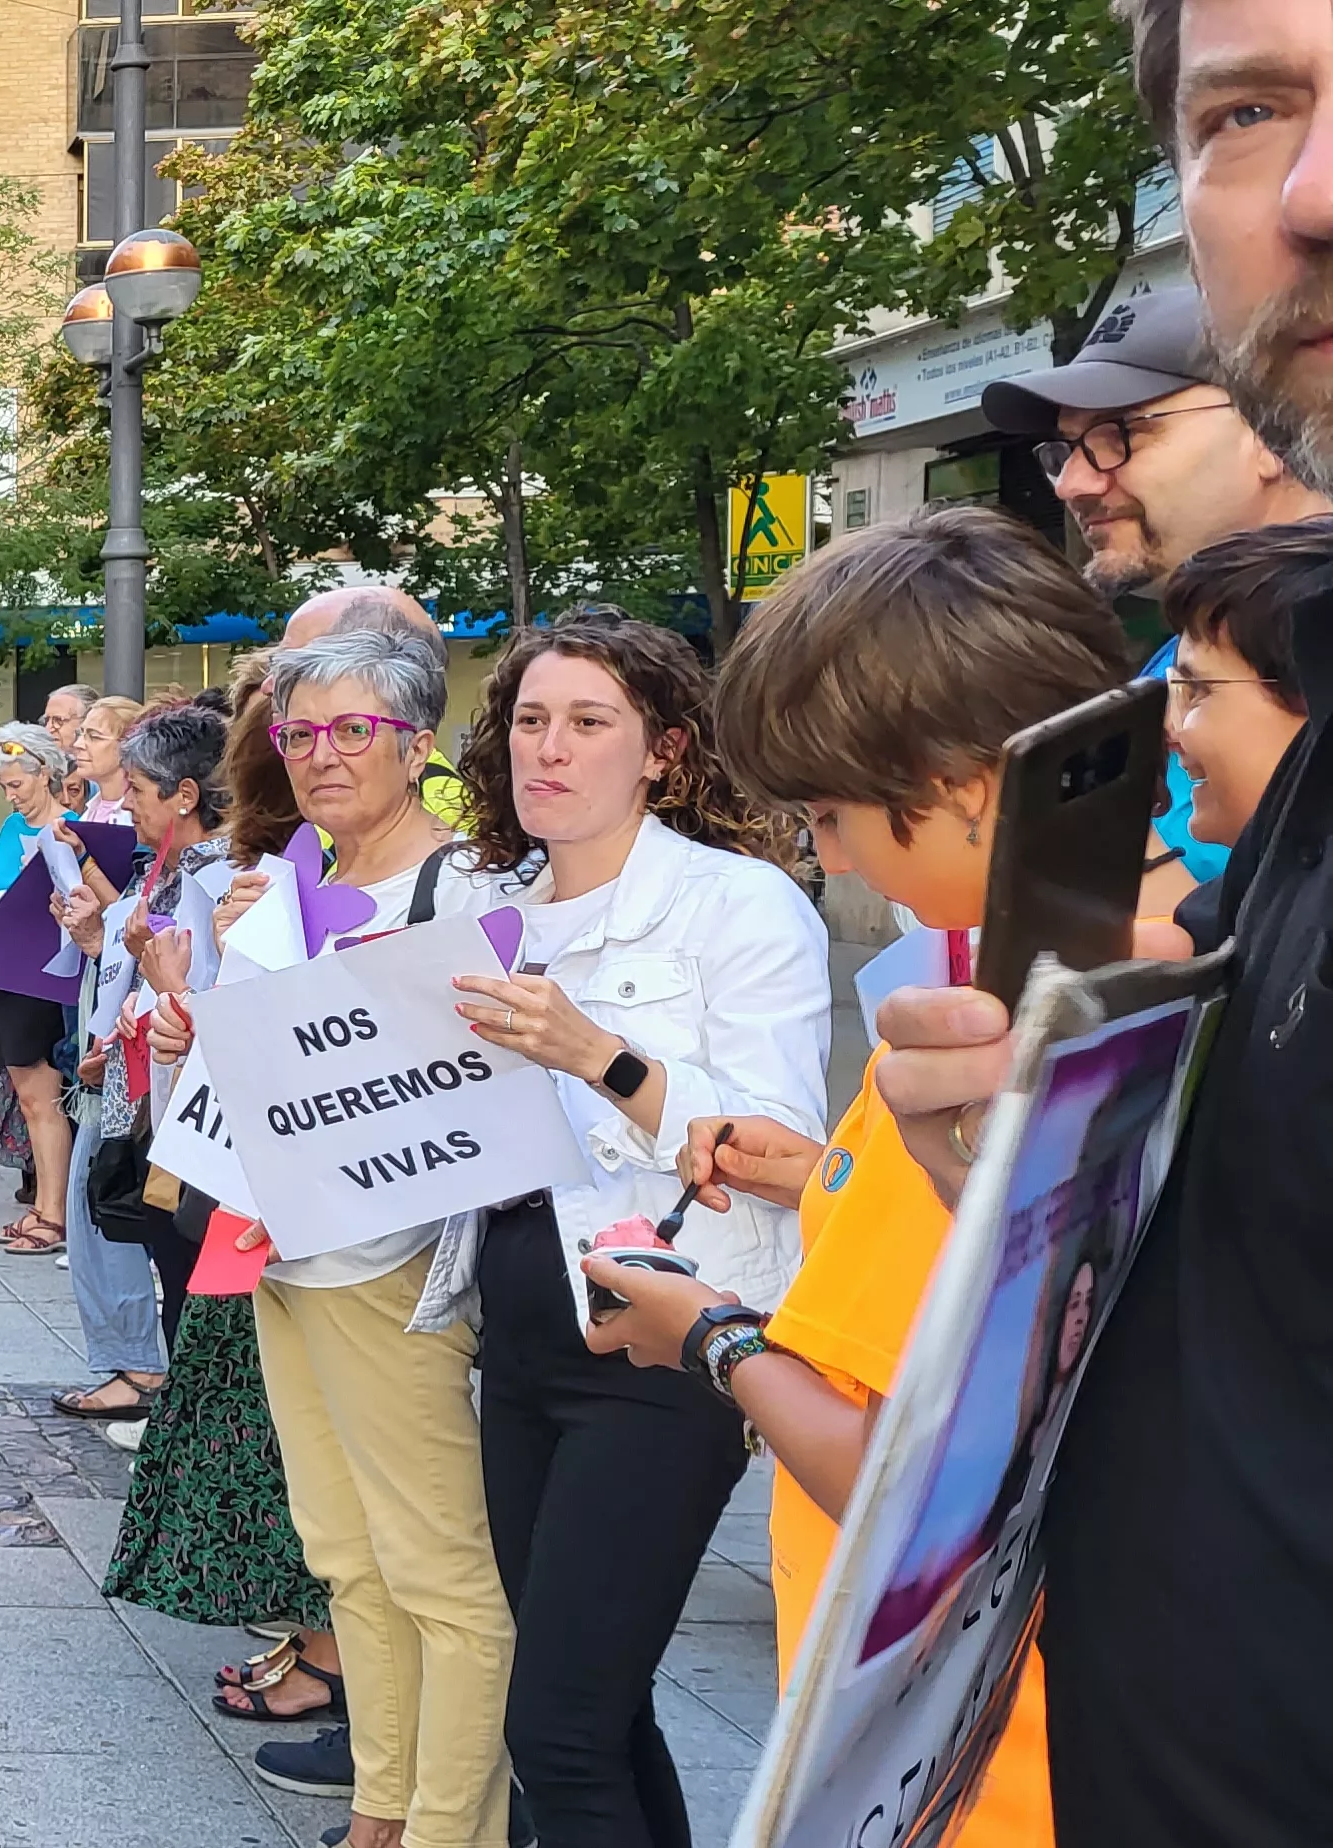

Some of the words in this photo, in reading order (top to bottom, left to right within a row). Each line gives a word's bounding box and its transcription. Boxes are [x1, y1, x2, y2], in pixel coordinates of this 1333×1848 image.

[292, 1007, 378, 1057] NOS
[267, 1050, 493, 1137] QUEREMOS
[339, 1129, 482, 1190] VIVAS
